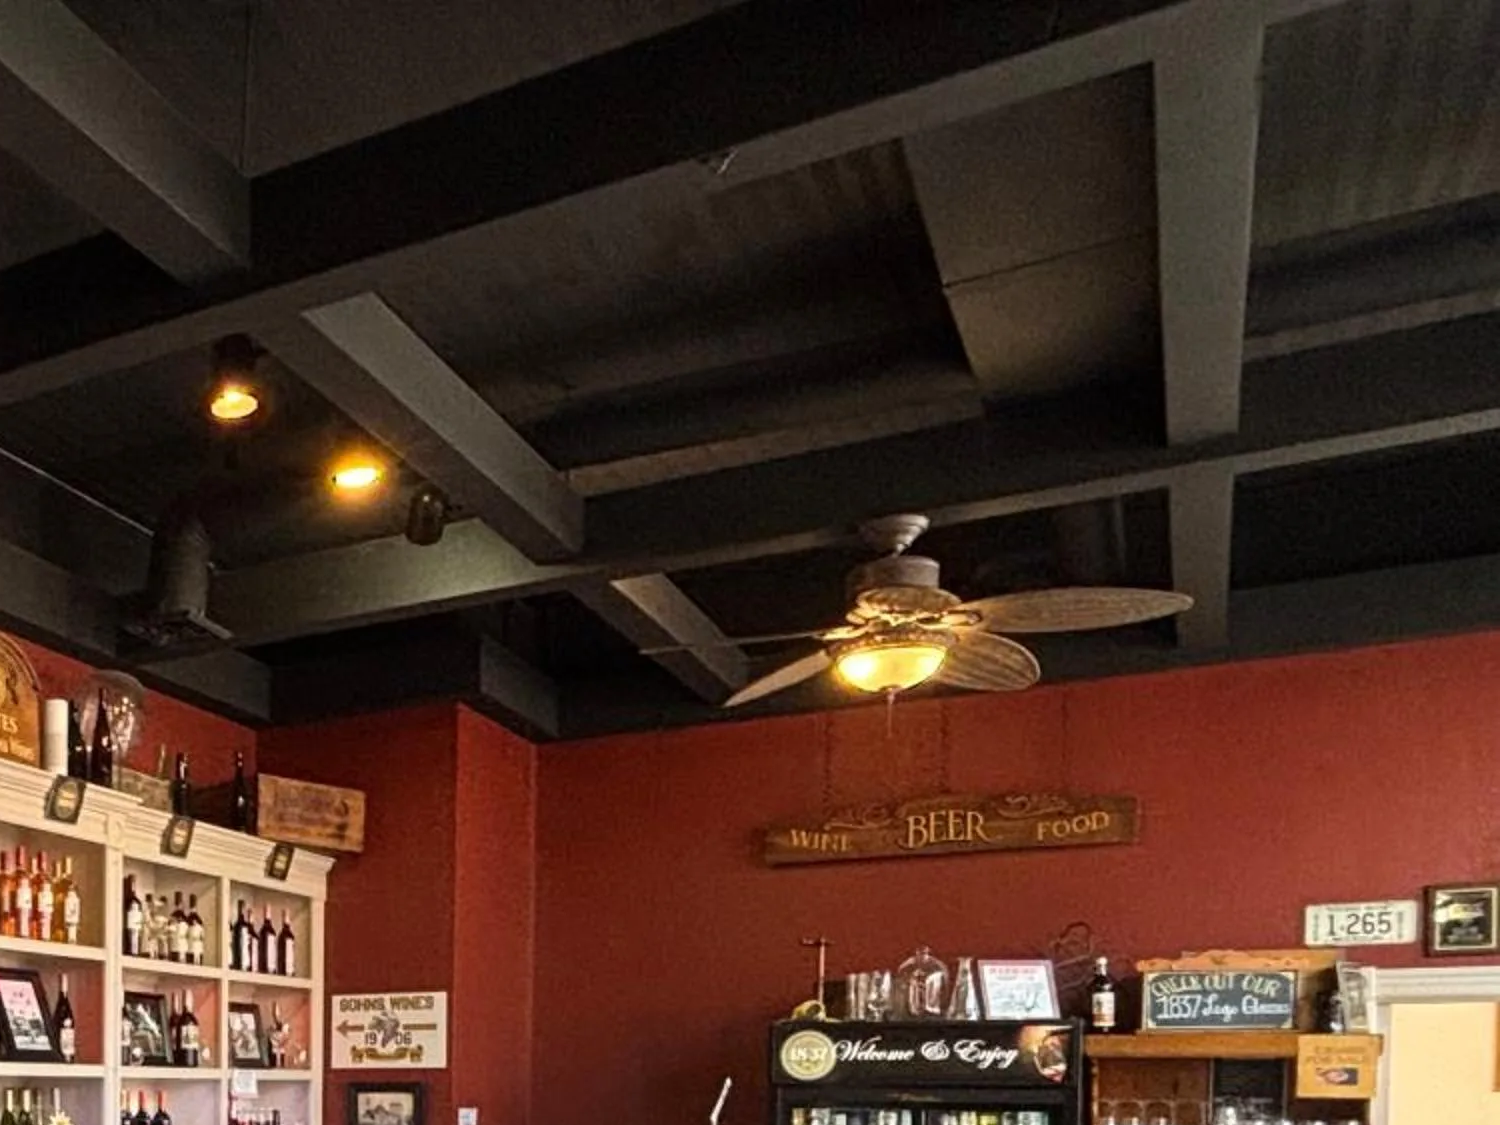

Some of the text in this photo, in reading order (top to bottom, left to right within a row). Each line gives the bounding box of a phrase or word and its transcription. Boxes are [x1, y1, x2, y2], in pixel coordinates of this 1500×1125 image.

[789, 811, 1111, 854] WINE BEER FOOD
[1204, 975, 1235, 991] OUT
[1241, 975, 1281, 998] OUR
[1155, 994, 1203, 1019] 1837
[832, 1035, 1020, 1070] Welcome & Enjoy
